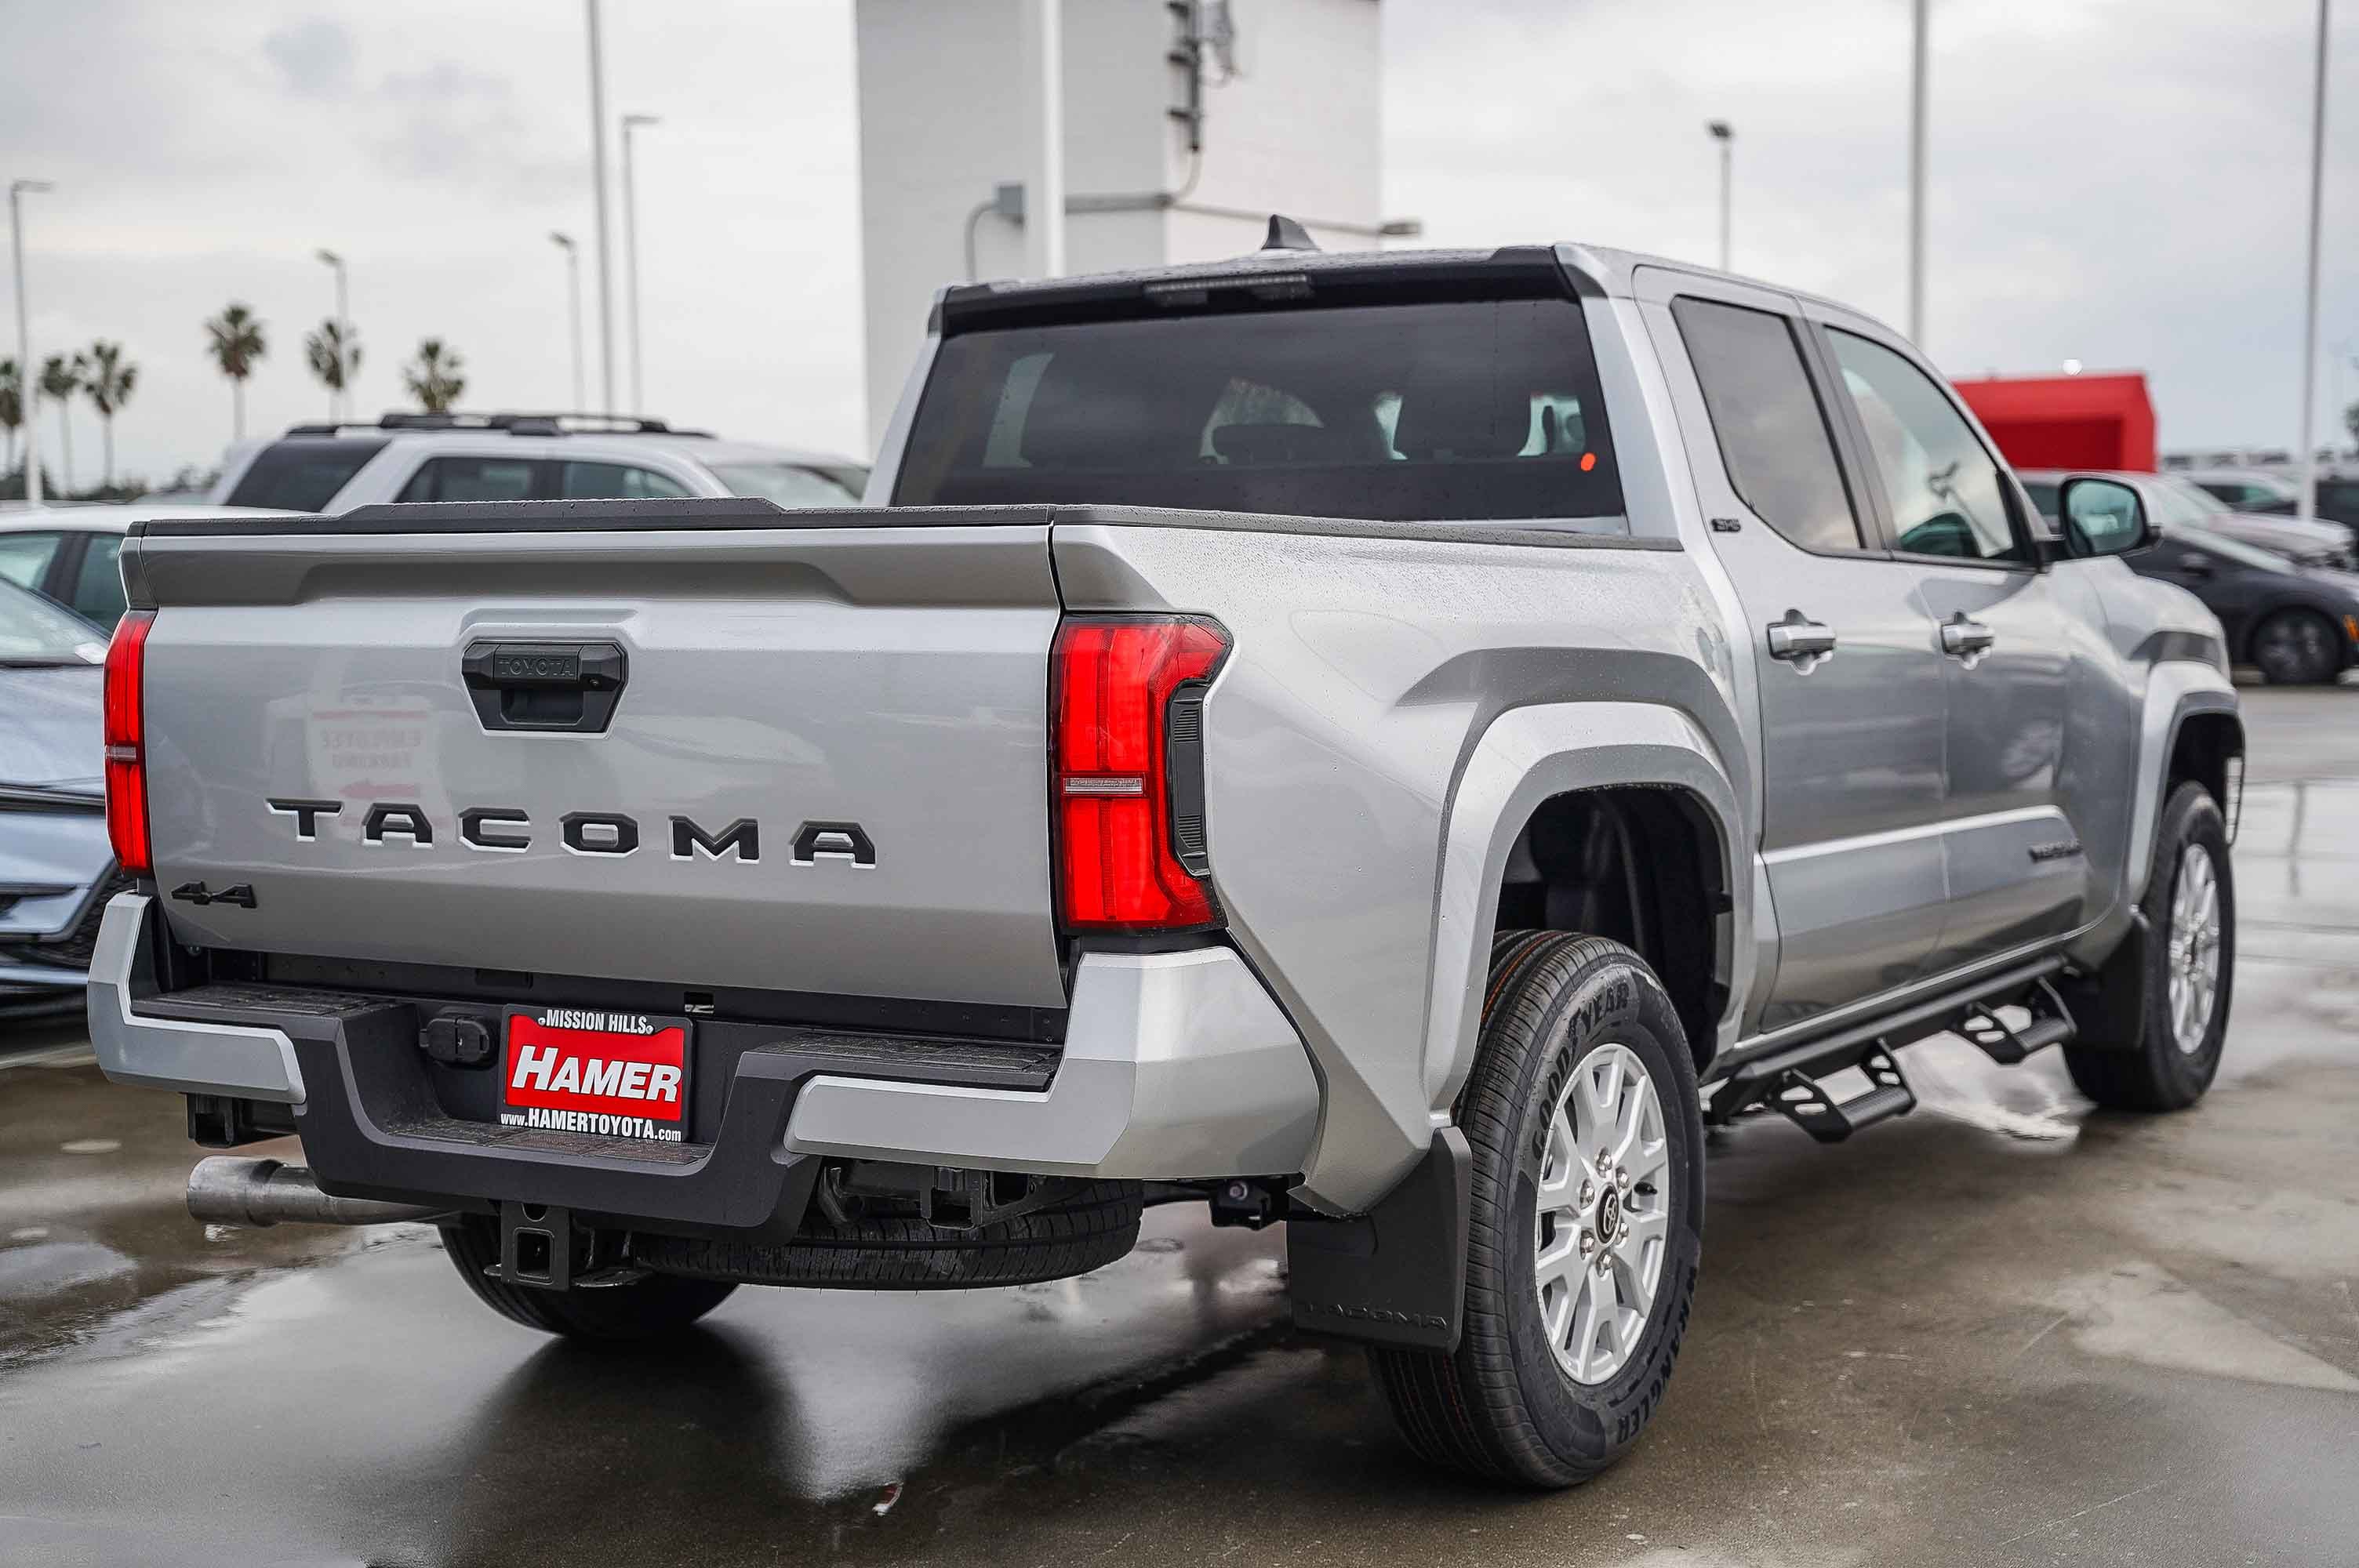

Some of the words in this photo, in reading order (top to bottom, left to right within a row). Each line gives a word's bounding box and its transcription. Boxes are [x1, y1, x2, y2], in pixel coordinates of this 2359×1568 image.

[498, 657, 575, 677] TOYOTA
[265, 798, 876, 869] TACOMA
[546, 1009, 605, 1031] MISSION
[608, 1014, 648, 1035] HILLS
[511, 1045, 683, 1103] HAMER
[1531, 982, 1630, 1160] GOODYEAR
[500, 1107, 682, 1142] www.HAMERTOYOTA.com
